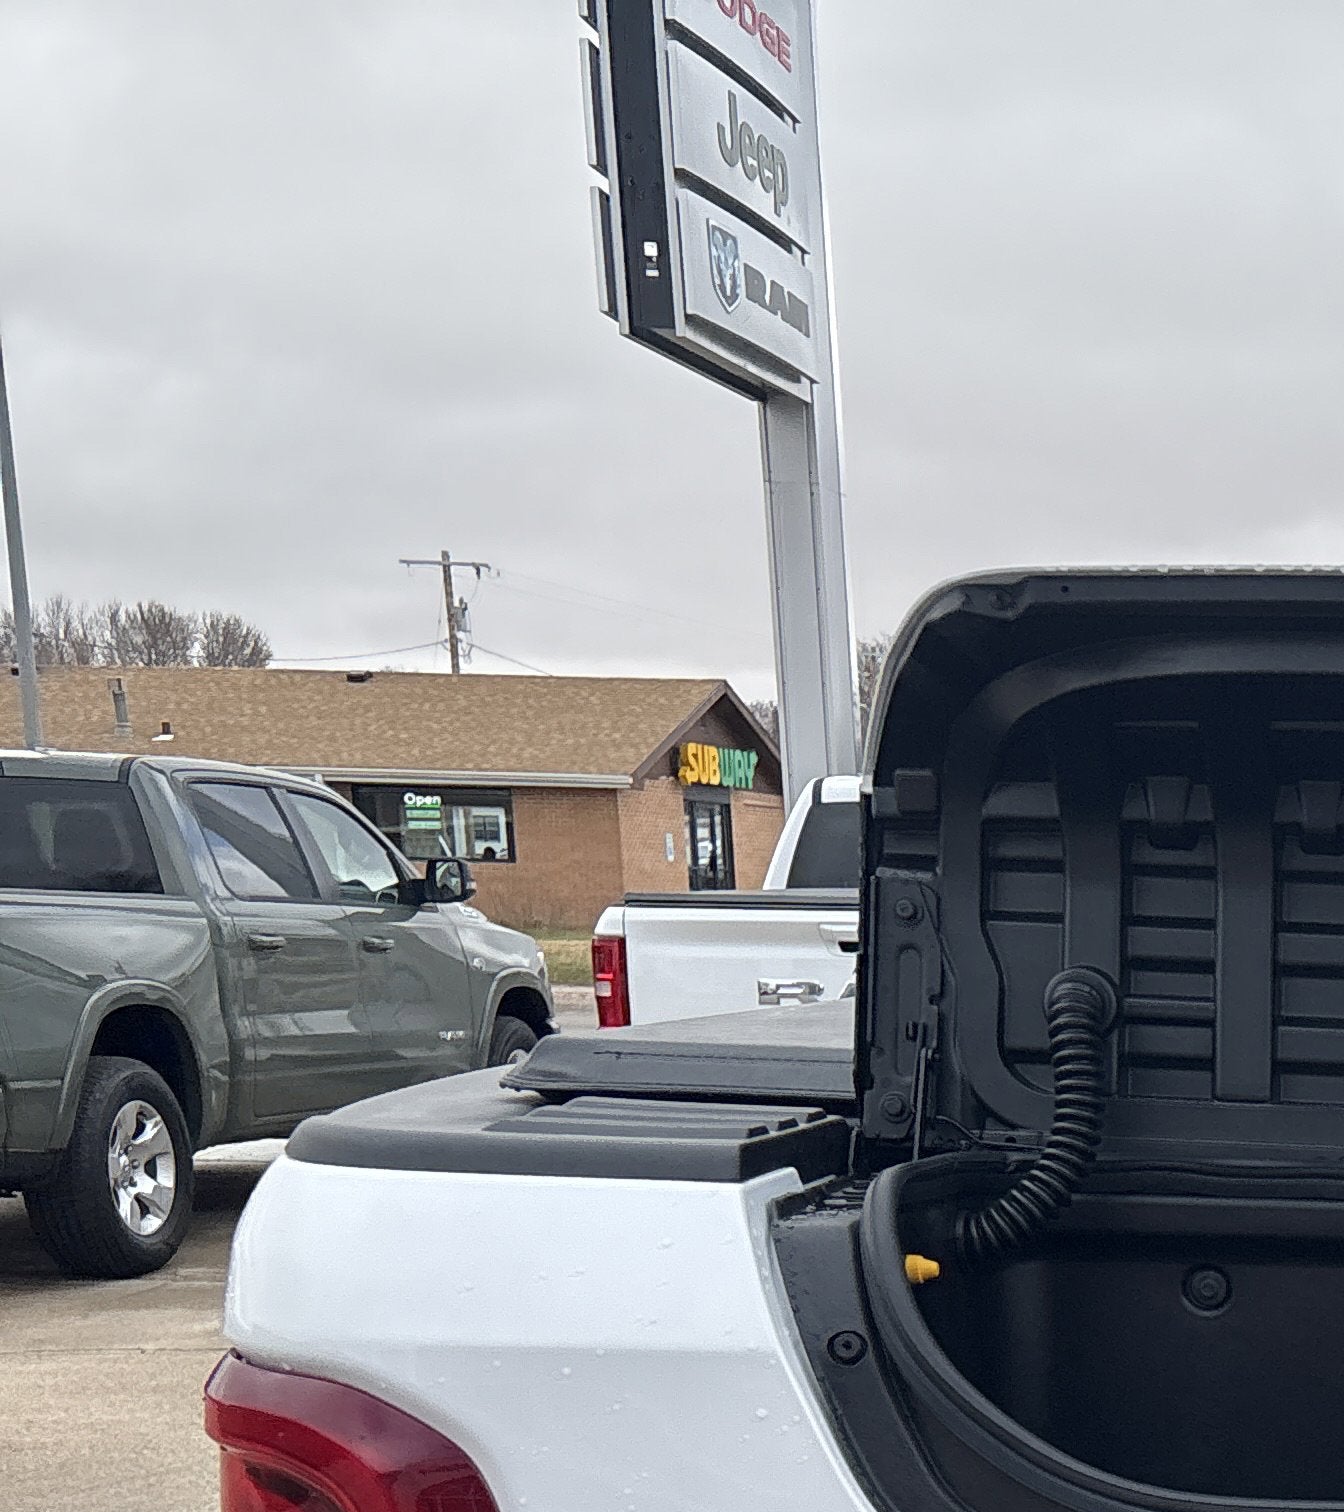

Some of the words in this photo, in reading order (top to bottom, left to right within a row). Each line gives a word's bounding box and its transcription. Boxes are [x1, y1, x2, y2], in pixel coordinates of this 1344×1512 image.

[717, 90, 789, 217] Jeep
[743, 262, 810, 338] RAM
[678, 742, 758, 790] SUBWAY
[403, 792, 442, 808] Open
